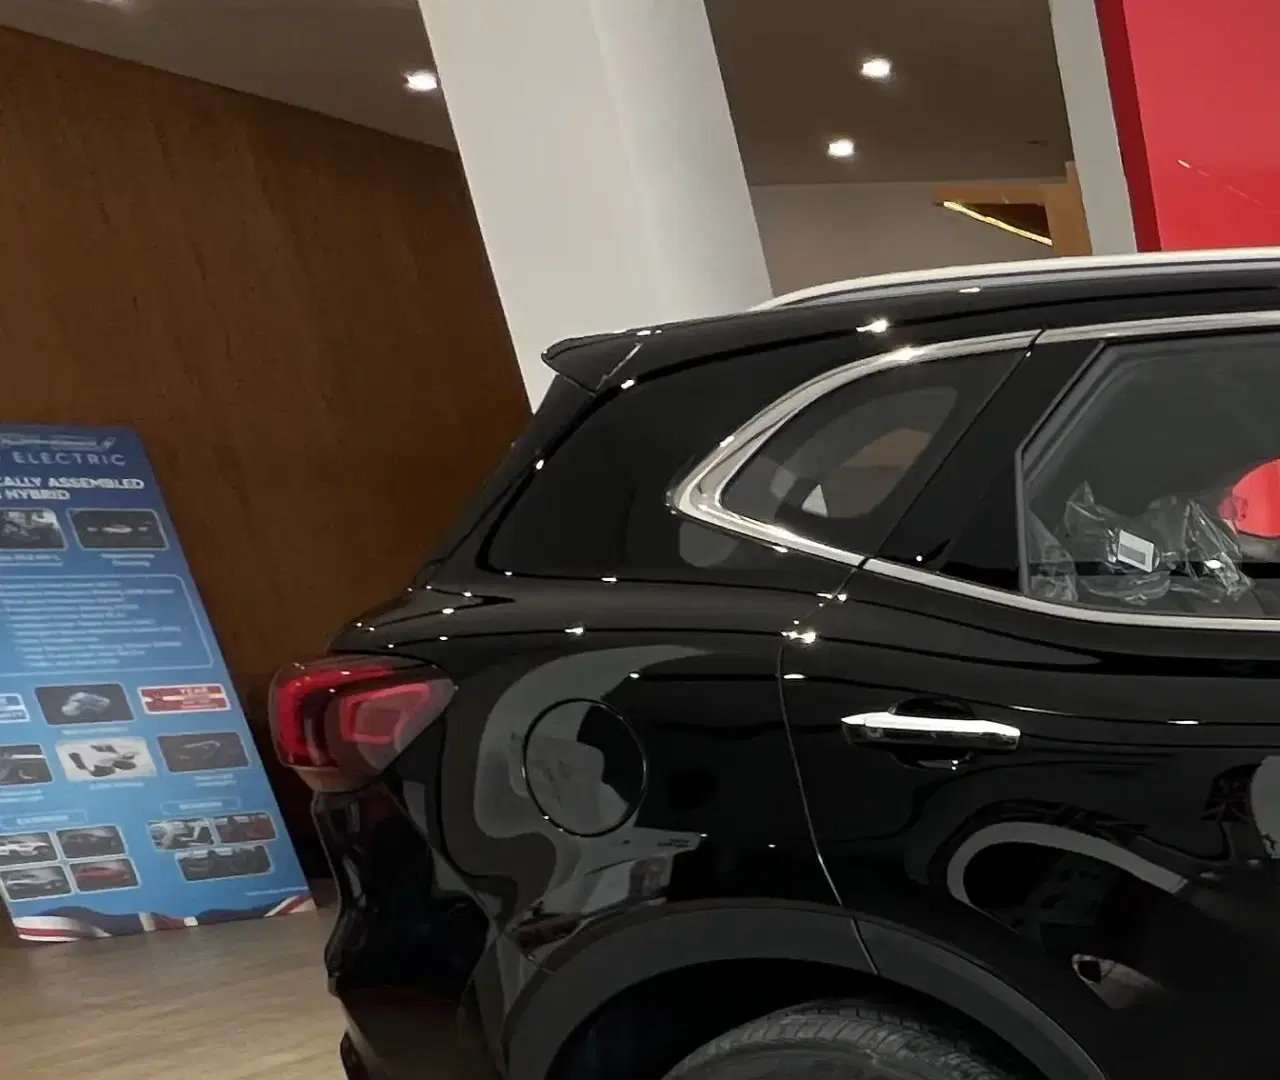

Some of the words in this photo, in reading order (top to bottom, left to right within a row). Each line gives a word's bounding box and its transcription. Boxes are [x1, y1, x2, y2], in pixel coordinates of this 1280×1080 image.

[12, 451, 126, 466] ELECTRIC
[48, 477, 145, 489] ASSEMBLED
[5, 489, 70, 500] HYBRID
